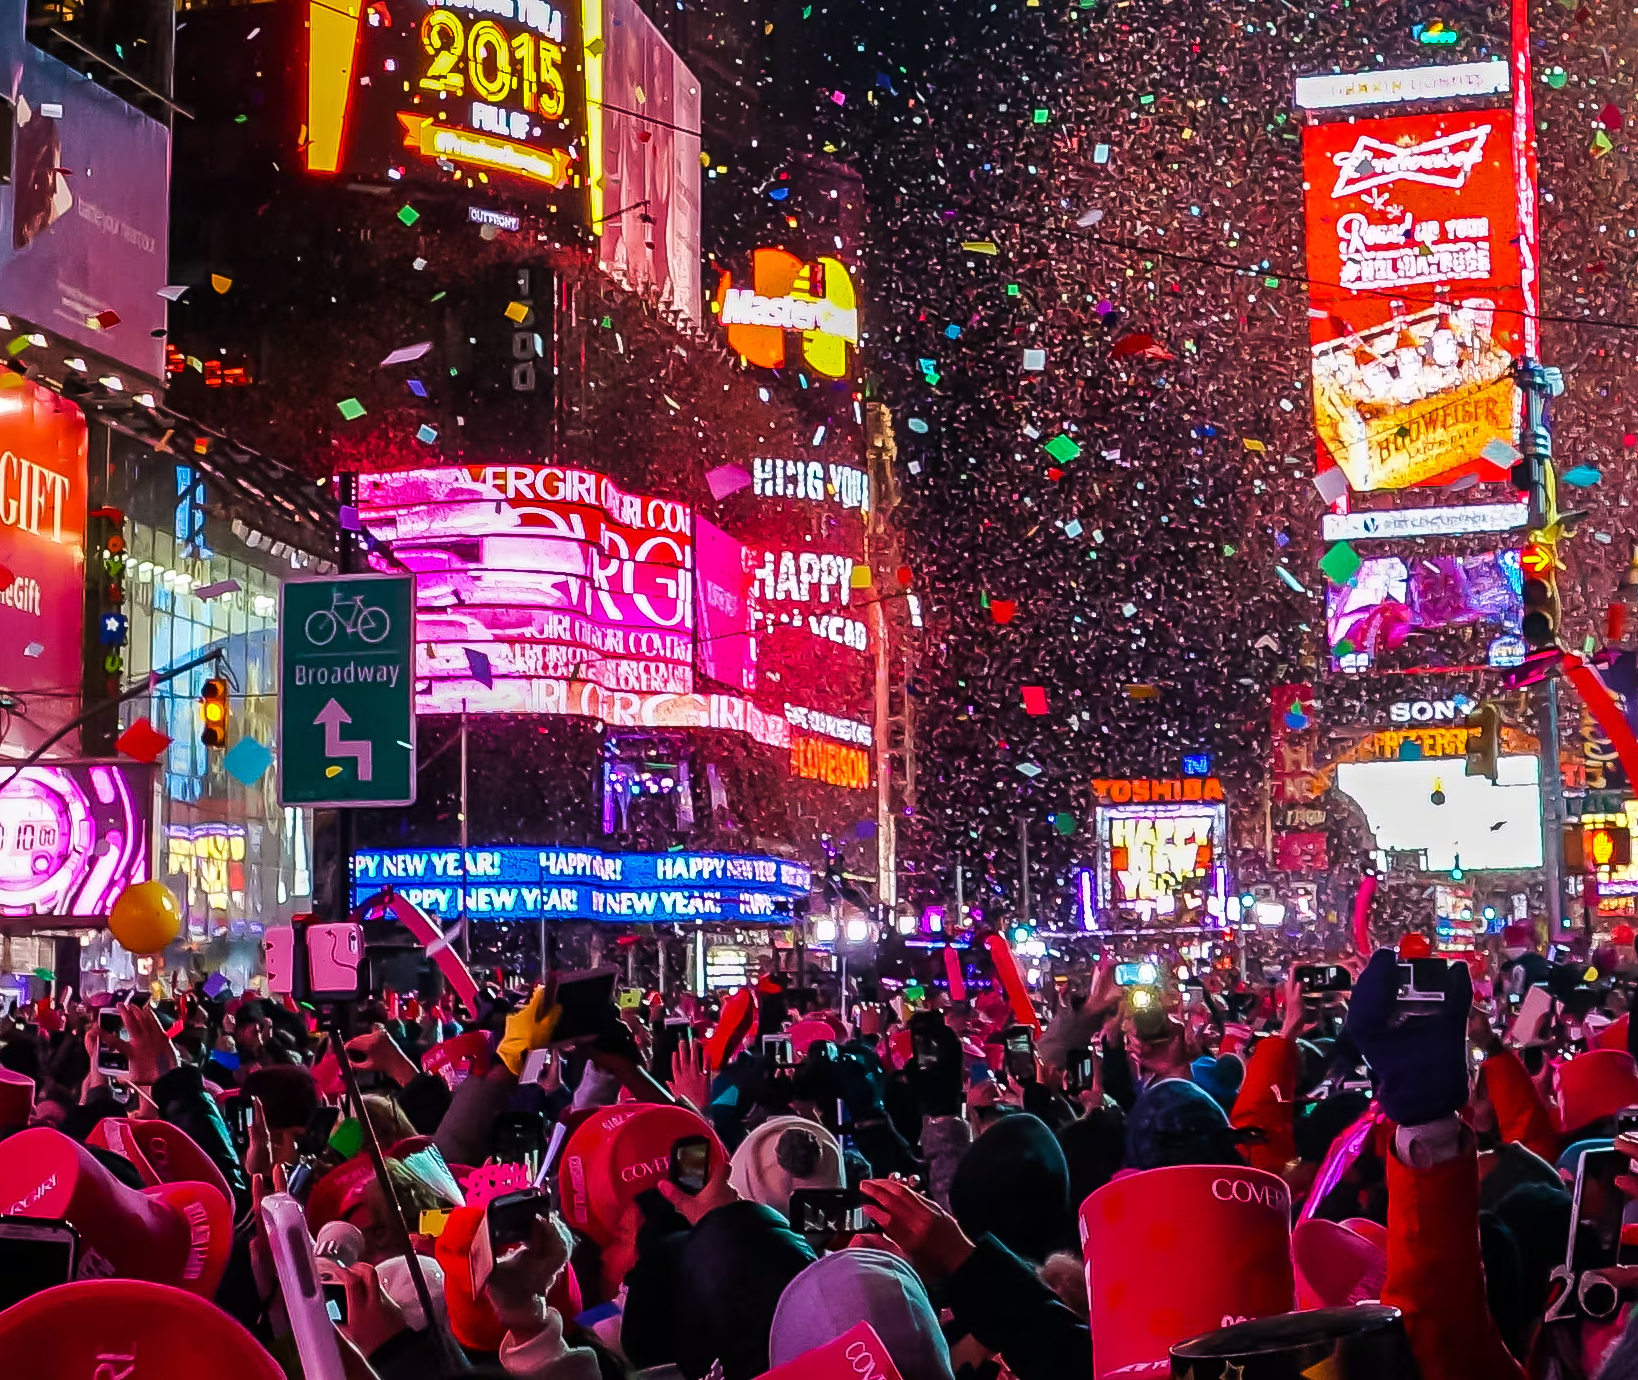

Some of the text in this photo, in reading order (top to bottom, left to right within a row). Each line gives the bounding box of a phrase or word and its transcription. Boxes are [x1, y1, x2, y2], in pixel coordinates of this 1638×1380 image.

[420, 10, 564, 120] 2015
[294, 662, 401, 688] Broadway
[1390, 701, 1475, 721] SONY
[382, 854, 428, 877] NEW
[430, 852, 501, 876] YEAR!
[657, 857, 725, 880] HAPPY
[457, 888, 519, 912] NEW
